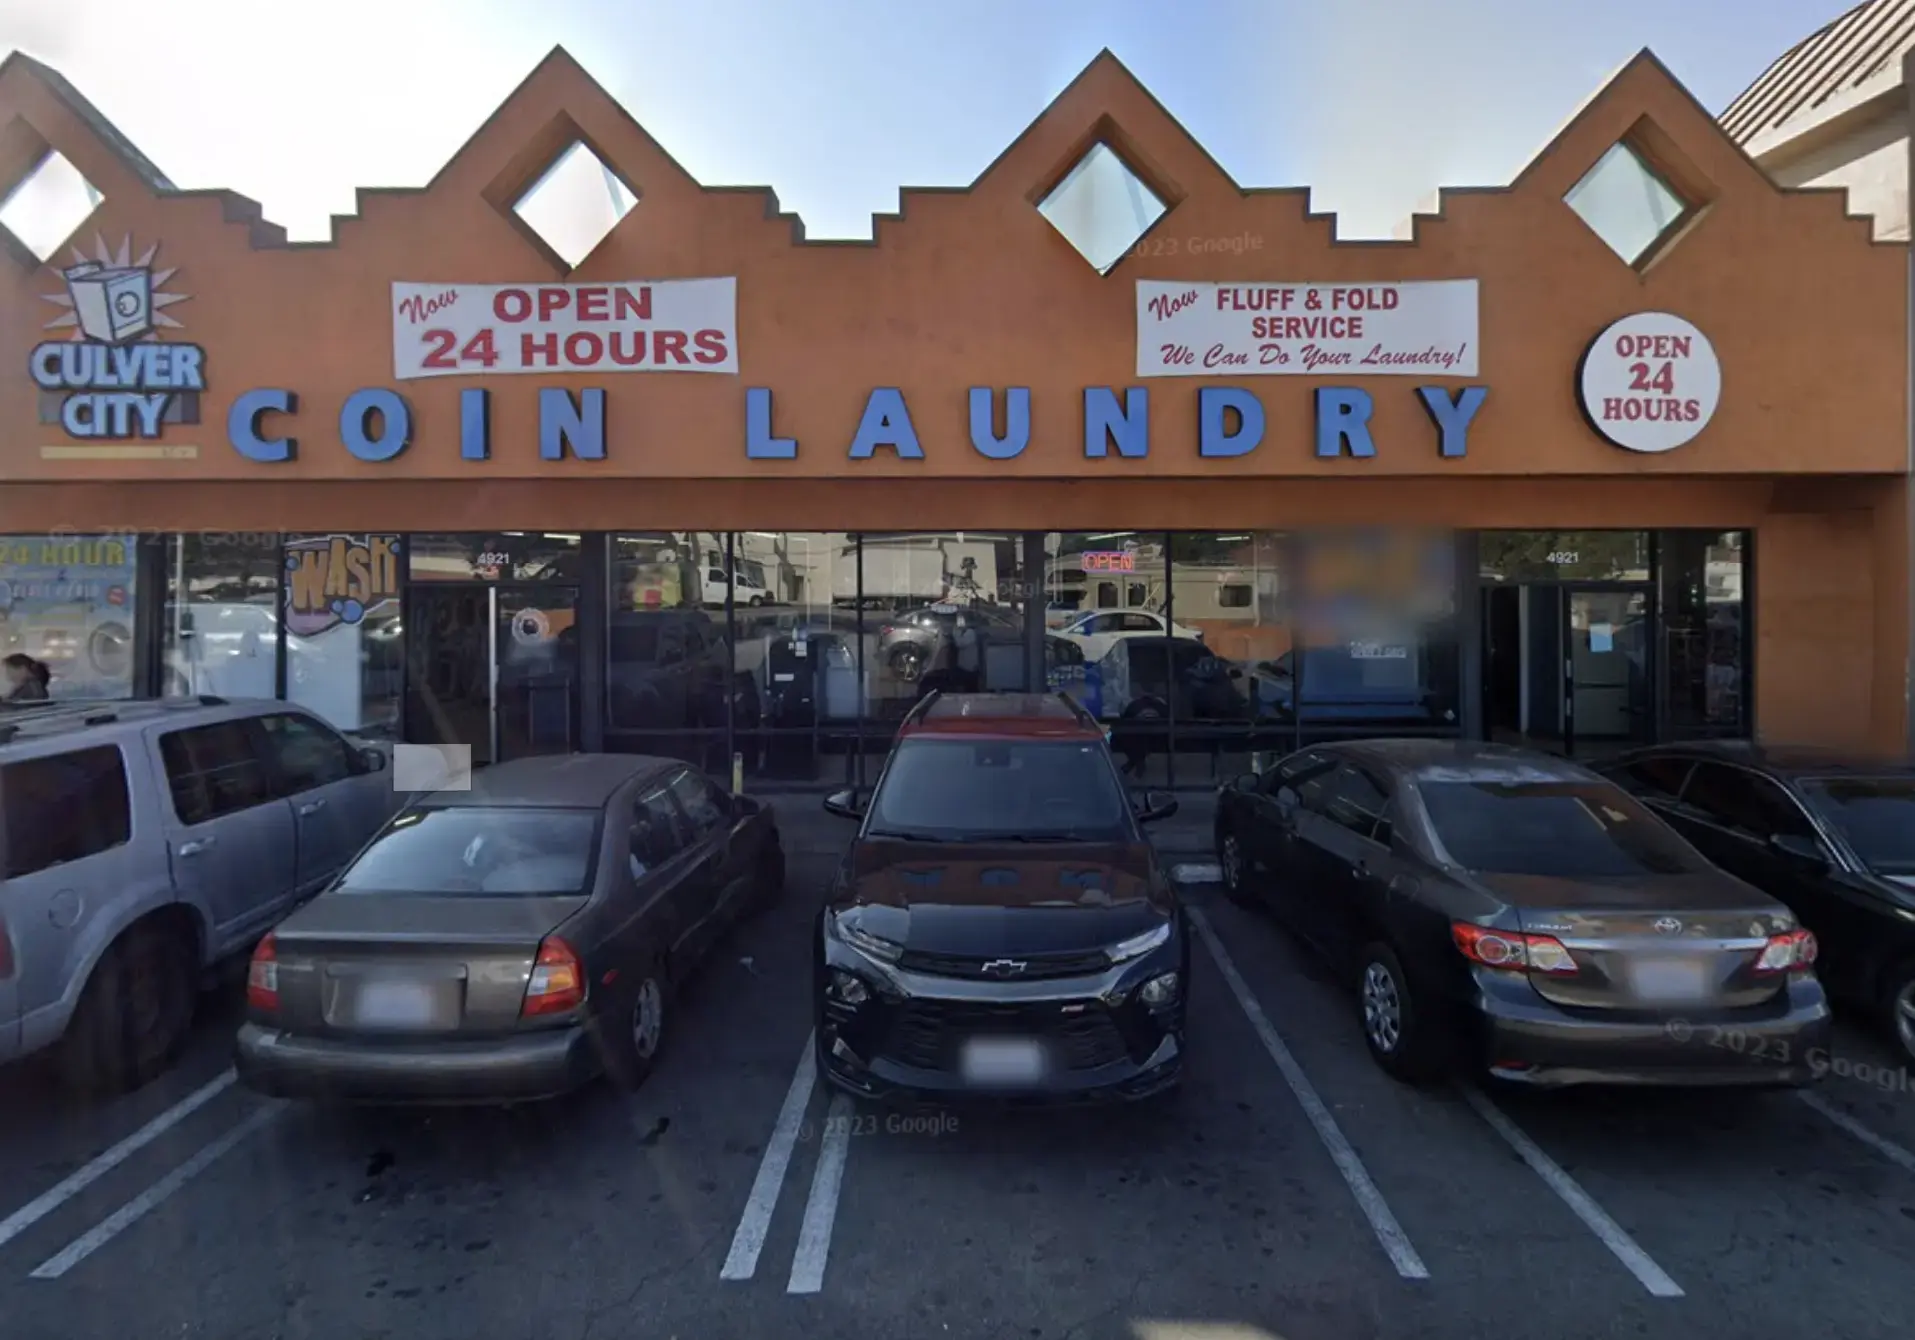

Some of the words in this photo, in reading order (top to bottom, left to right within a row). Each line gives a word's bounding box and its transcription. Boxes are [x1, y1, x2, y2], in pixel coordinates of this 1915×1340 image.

[399, 288, 459, 324] Now
[492, 287, 653, 322] OPEN
[1148, 289, 1199, 322] Now
[1216, 288, 1295, 311] FLUFF
[1304, 290, 1322, 310] &
[1331, 288, 1399, 310] FOLD
[1251, 316, 1363, 339] SERVICE
[420, 328, 499, 369] 24
[520, 329, 729, 366] HOURS
[1160, 344, 1195, 366] We
[1203, 344, 1249, 368] Can
[1258, 343, 1291, 365] Do
[1300, 344, 1352, 371] Your
[1360, 342, 1467, 368] Laundry!
[1616, 335, 1692, 358] OPEN
[31, 343, 203, 388] CULVER
[1628, 361, 1674, 395] 24
[62, 393, 170, 437] CITY
[228, 387, 607, 463] COIN
[746, 386, 1488, 461] LAUNDRY
[1603, 397, 1700, 421] HOURS
[41, 541, 125, 566] HOUR
[476, 551, 510, 564] 4921
[1084, 553, 1134, 571] OPEN
[1545, 551, 1579, 564] 4921
[288, 536, 396, 608] WASH
